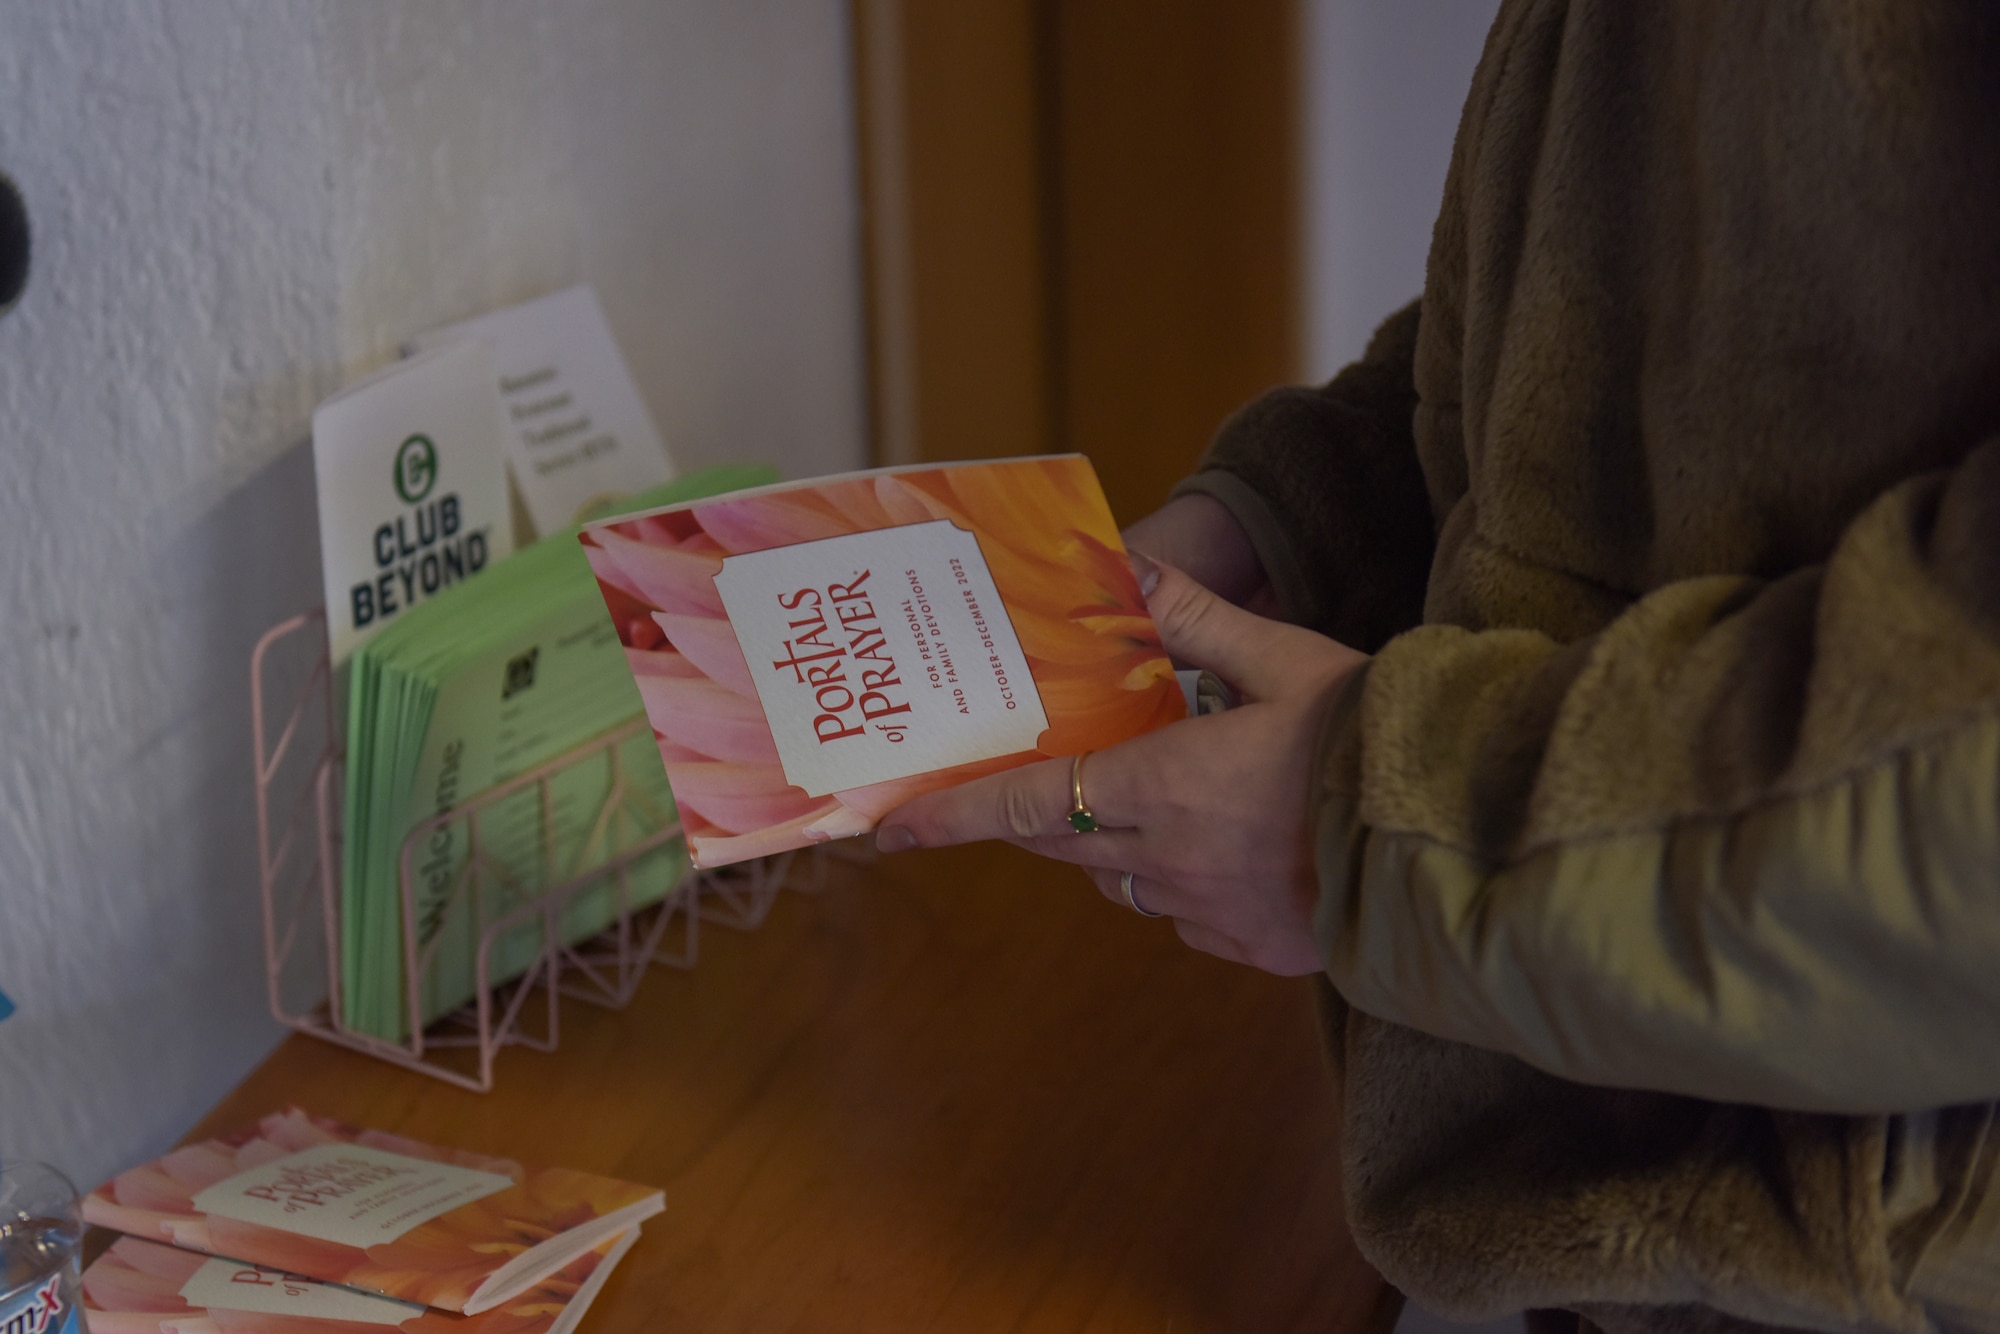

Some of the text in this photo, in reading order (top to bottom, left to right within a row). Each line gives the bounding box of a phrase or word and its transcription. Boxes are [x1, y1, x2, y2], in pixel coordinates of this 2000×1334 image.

[375, 493, 462, 568] CLUB
[949, 559, 969, 584] 2022
[351, 530, 488, 630] BEYOND
[773, 587, 866, 744] PORTALS
[902, 599, 942, 688] FOR PERSONAL
[905, 569, 969, 714] AND FAMILY DEVOTIONS
[876, 725, 907, 743] of
